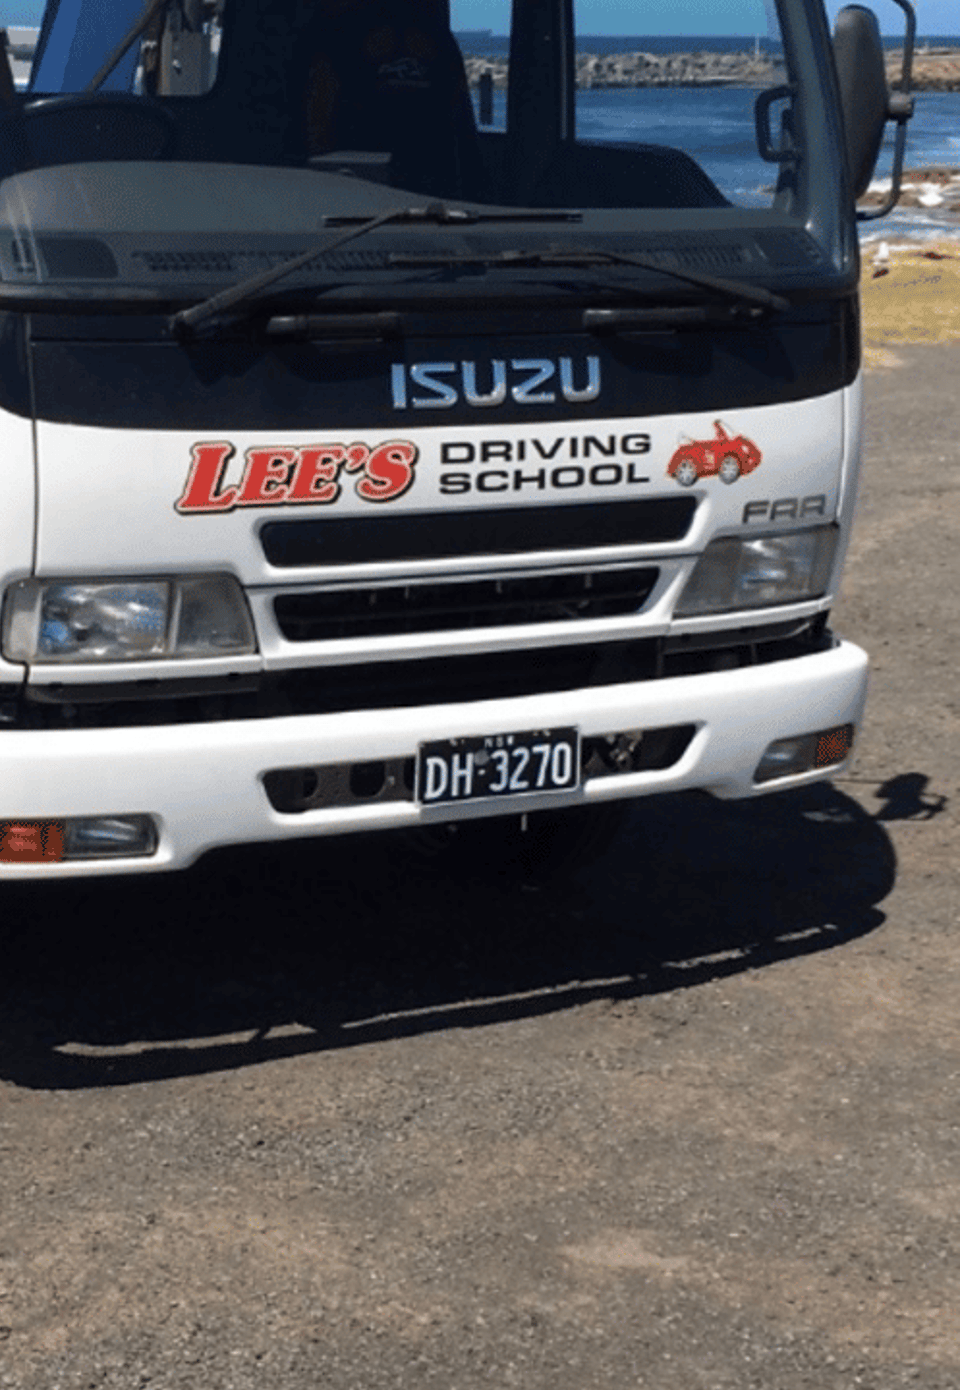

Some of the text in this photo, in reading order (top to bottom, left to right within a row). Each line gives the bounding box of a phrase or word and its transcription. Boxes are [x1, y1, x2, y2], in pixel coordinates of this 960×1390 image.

[391, 356, 601, 409] ISUZU
[440, 433, 652, 465] DRIVING
[174, 439, 420, 516] LEE'S
[439, 463, 651, 495] SCHOOL
[424, 741, 573, 801] DH-3270
